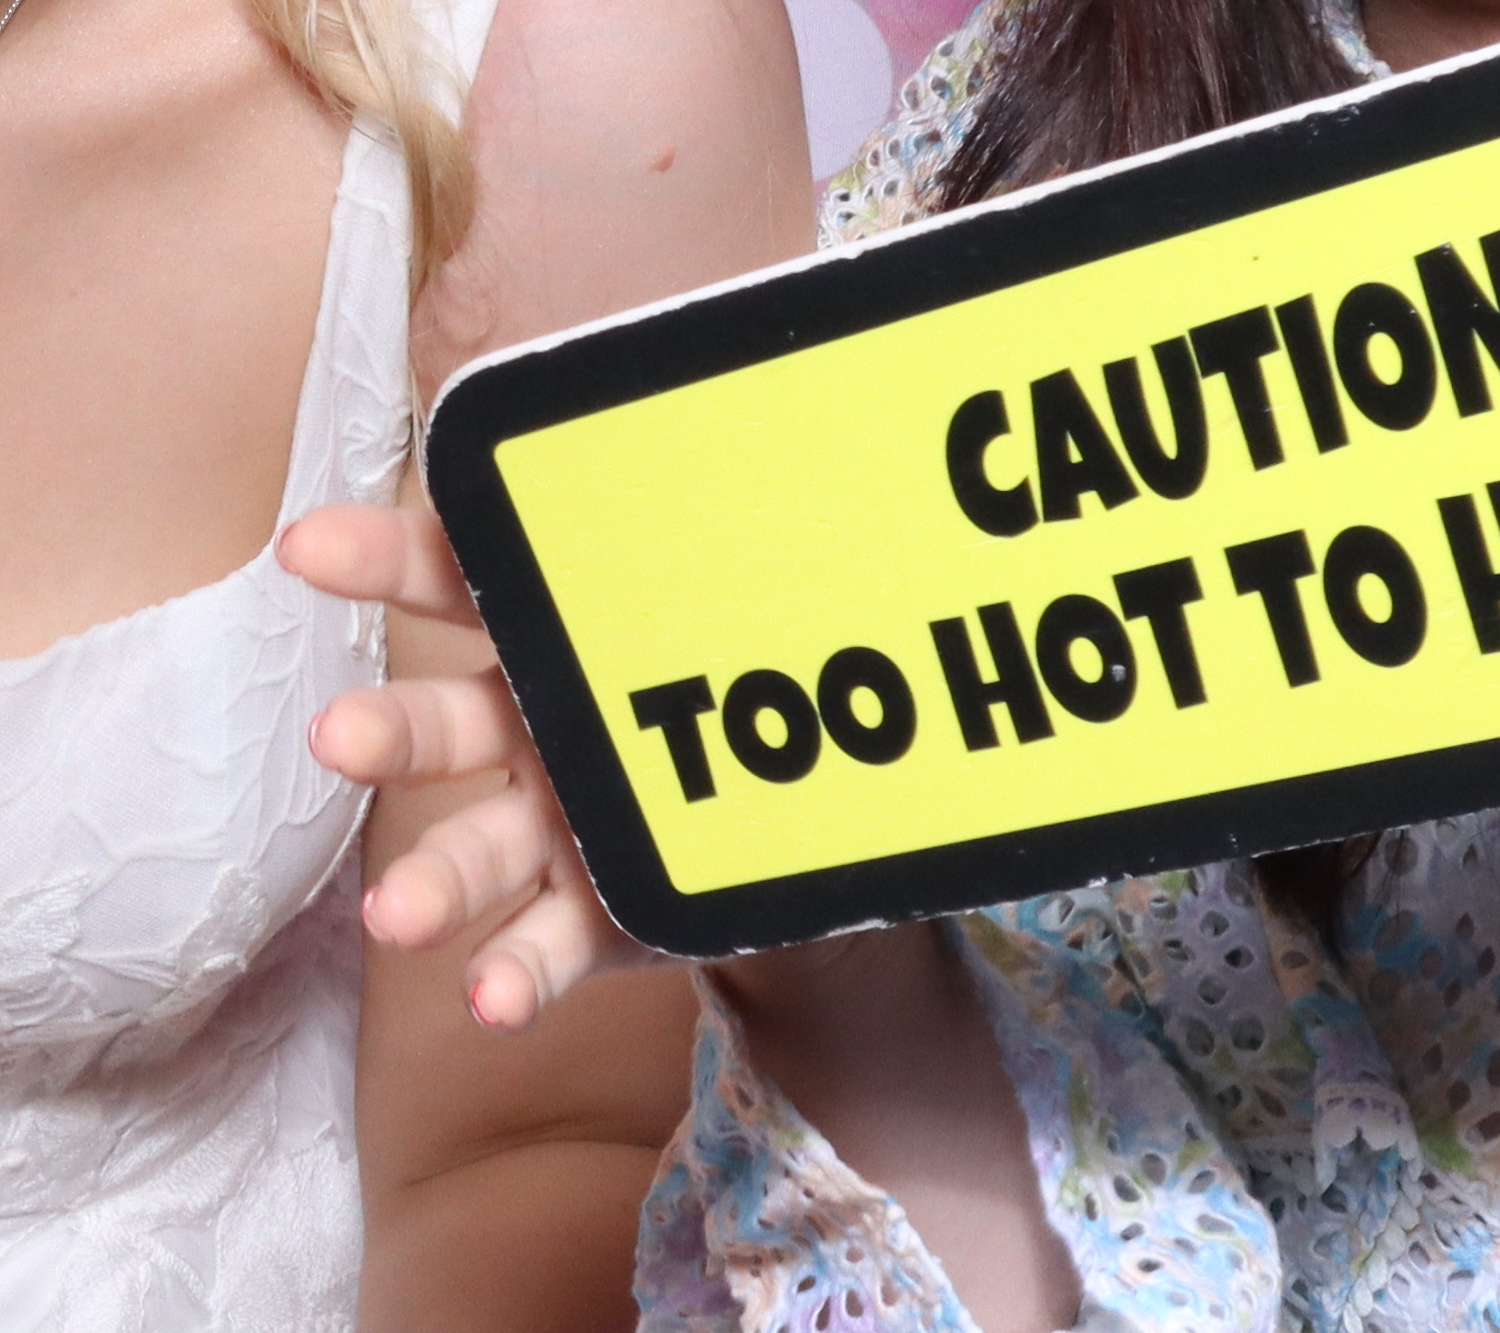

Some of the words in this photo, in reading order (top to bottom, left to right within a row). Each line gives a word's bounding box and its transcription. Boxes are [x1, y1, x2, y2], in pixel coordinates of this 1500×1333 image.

[628, 645, 917, 803] TOO
[929, 556, 1207, 752] HOT
[1224, 525, 1428, 688] TO
